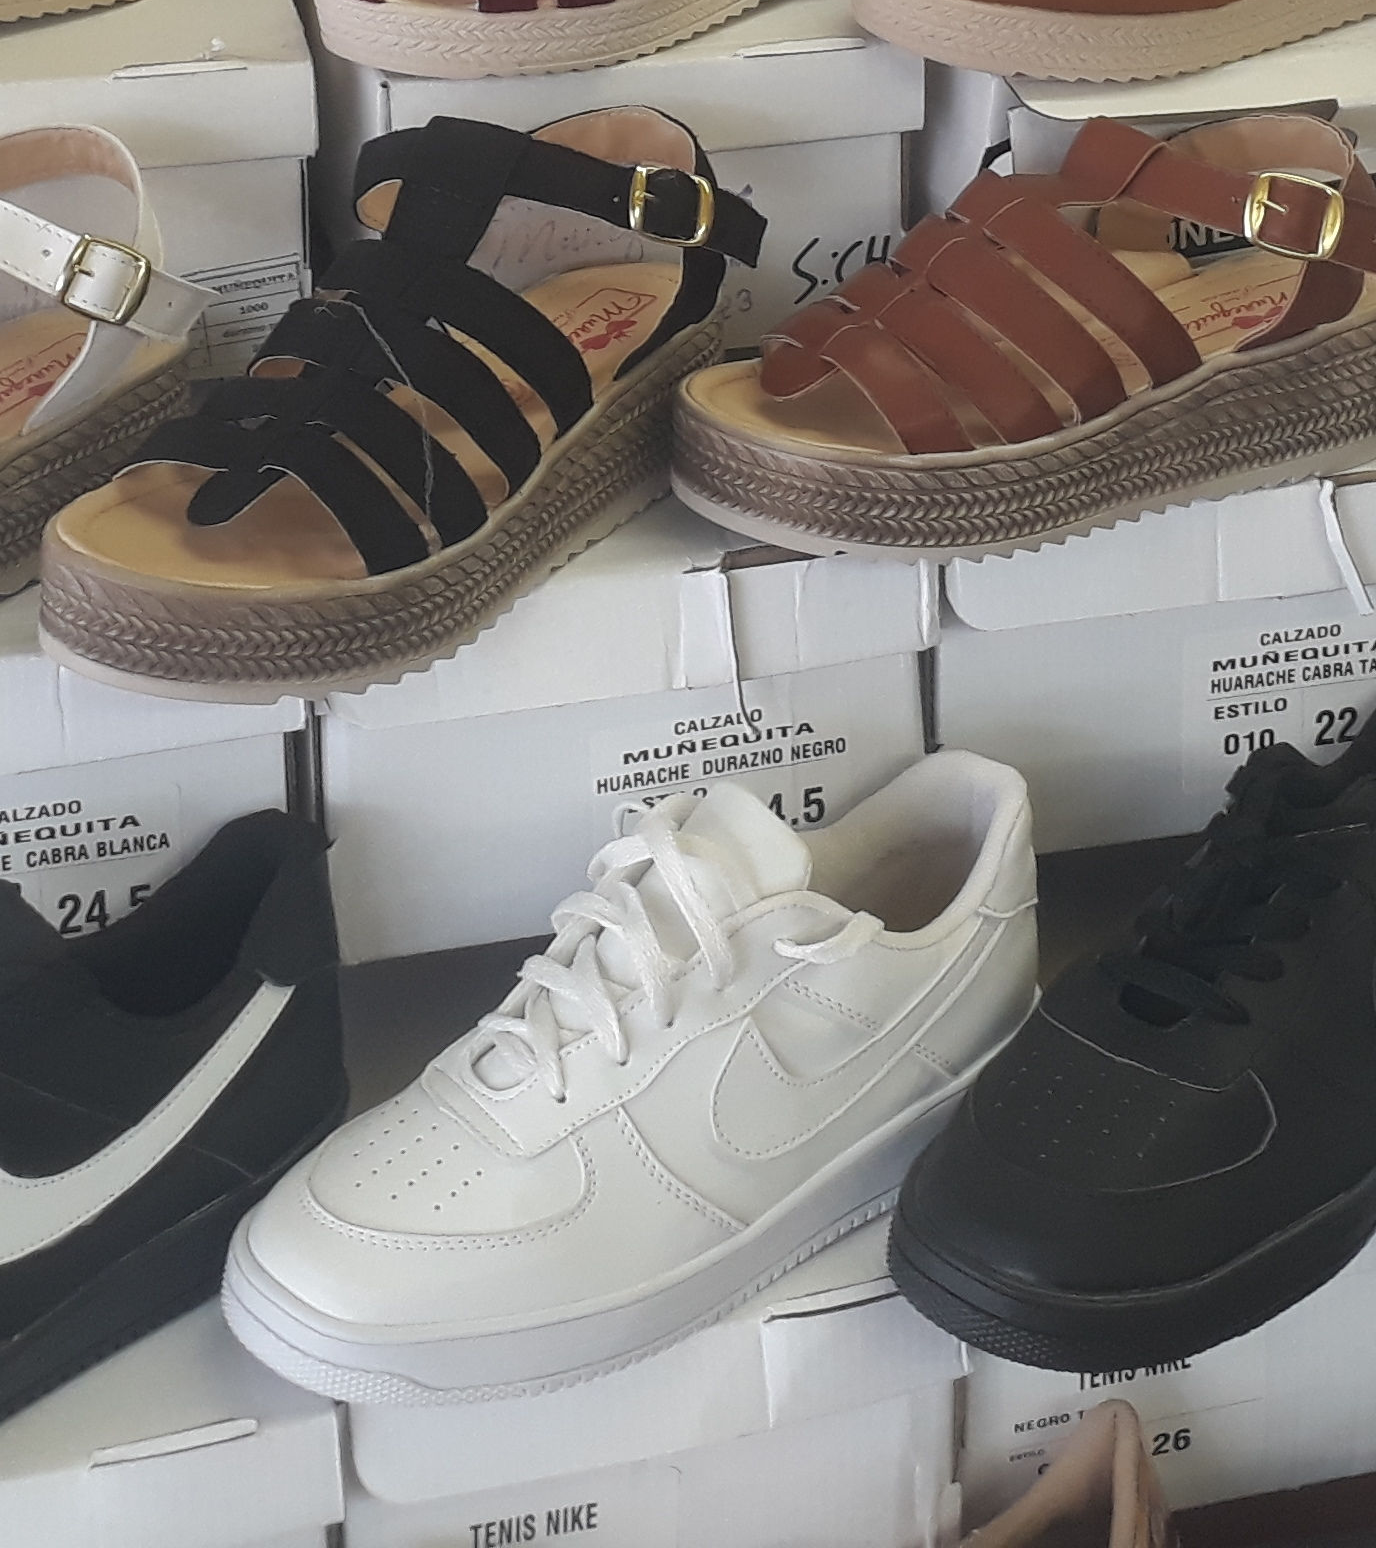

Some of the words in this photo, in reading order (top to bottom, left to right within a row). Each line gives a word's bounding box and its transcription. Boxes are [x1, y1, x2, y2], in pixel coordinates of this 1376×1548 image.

[1260, 624, 1342, 646] CALZADO
[1210, 668, 1296, 694] HUARACHE
[1302, 661, 1354, 682] CABRA
[1214, 697, 1288, 720] ESTILO
[623, 722, 815, 765] MUÑEQUITA
[1224, 728, 1275, 755] 010
[597, 764, 690, 794] HUARACHE
[703, 747, 783, 776] DURAZNO
[791, 737, 847, 761] NEGRO
[26, 843, 90, 868] CABRA
[96, 832, 171, 858] BLANCA
[1013, 1412, 1071, 1434] NEGRO
[1151, 1428, 1192, 1456] 26
[469, 1513, 537, 1548] TENIS
[546, 1502, 598, 1537] NIKE
